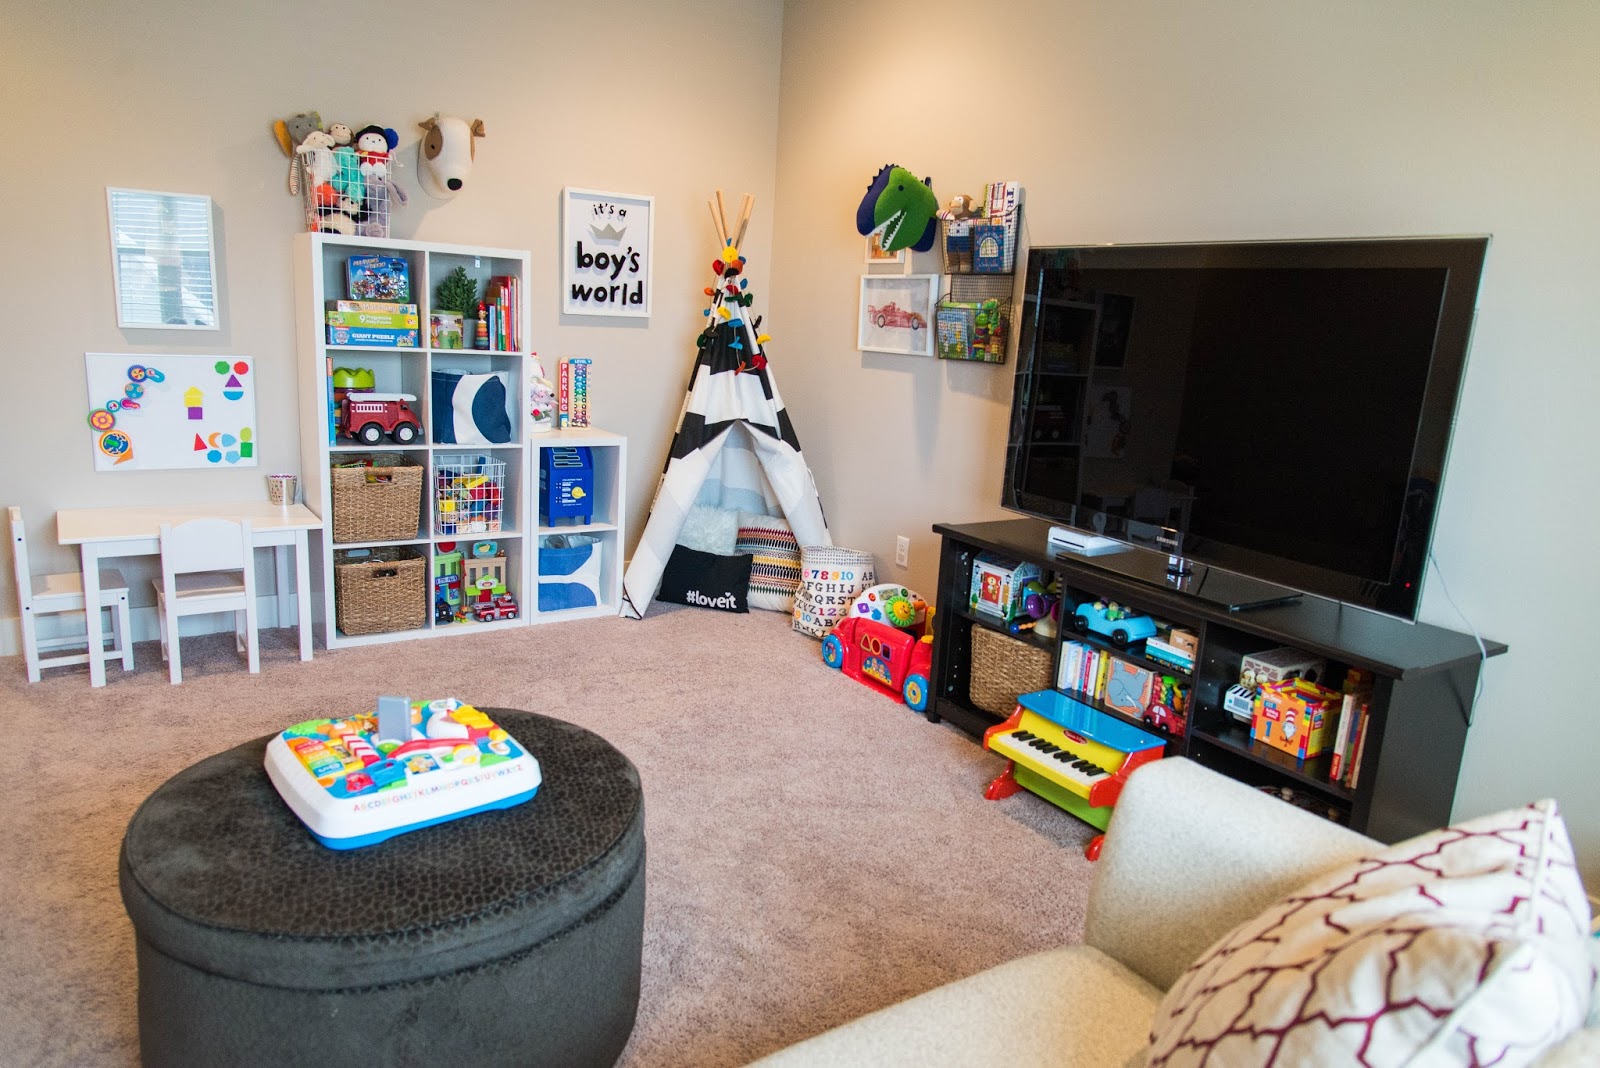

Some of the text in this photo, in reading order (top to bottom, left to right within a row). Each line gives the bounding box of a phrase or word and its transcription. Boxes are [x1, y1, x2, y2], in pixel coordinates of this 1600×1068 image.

[593, 203, 627, 217] it's a
[577, 241, 640, 281] boy's
[572, 280, 643, 305] world
[686, 590, 737, 609] #loveit
[1266, 721, 1272, 737] 1
